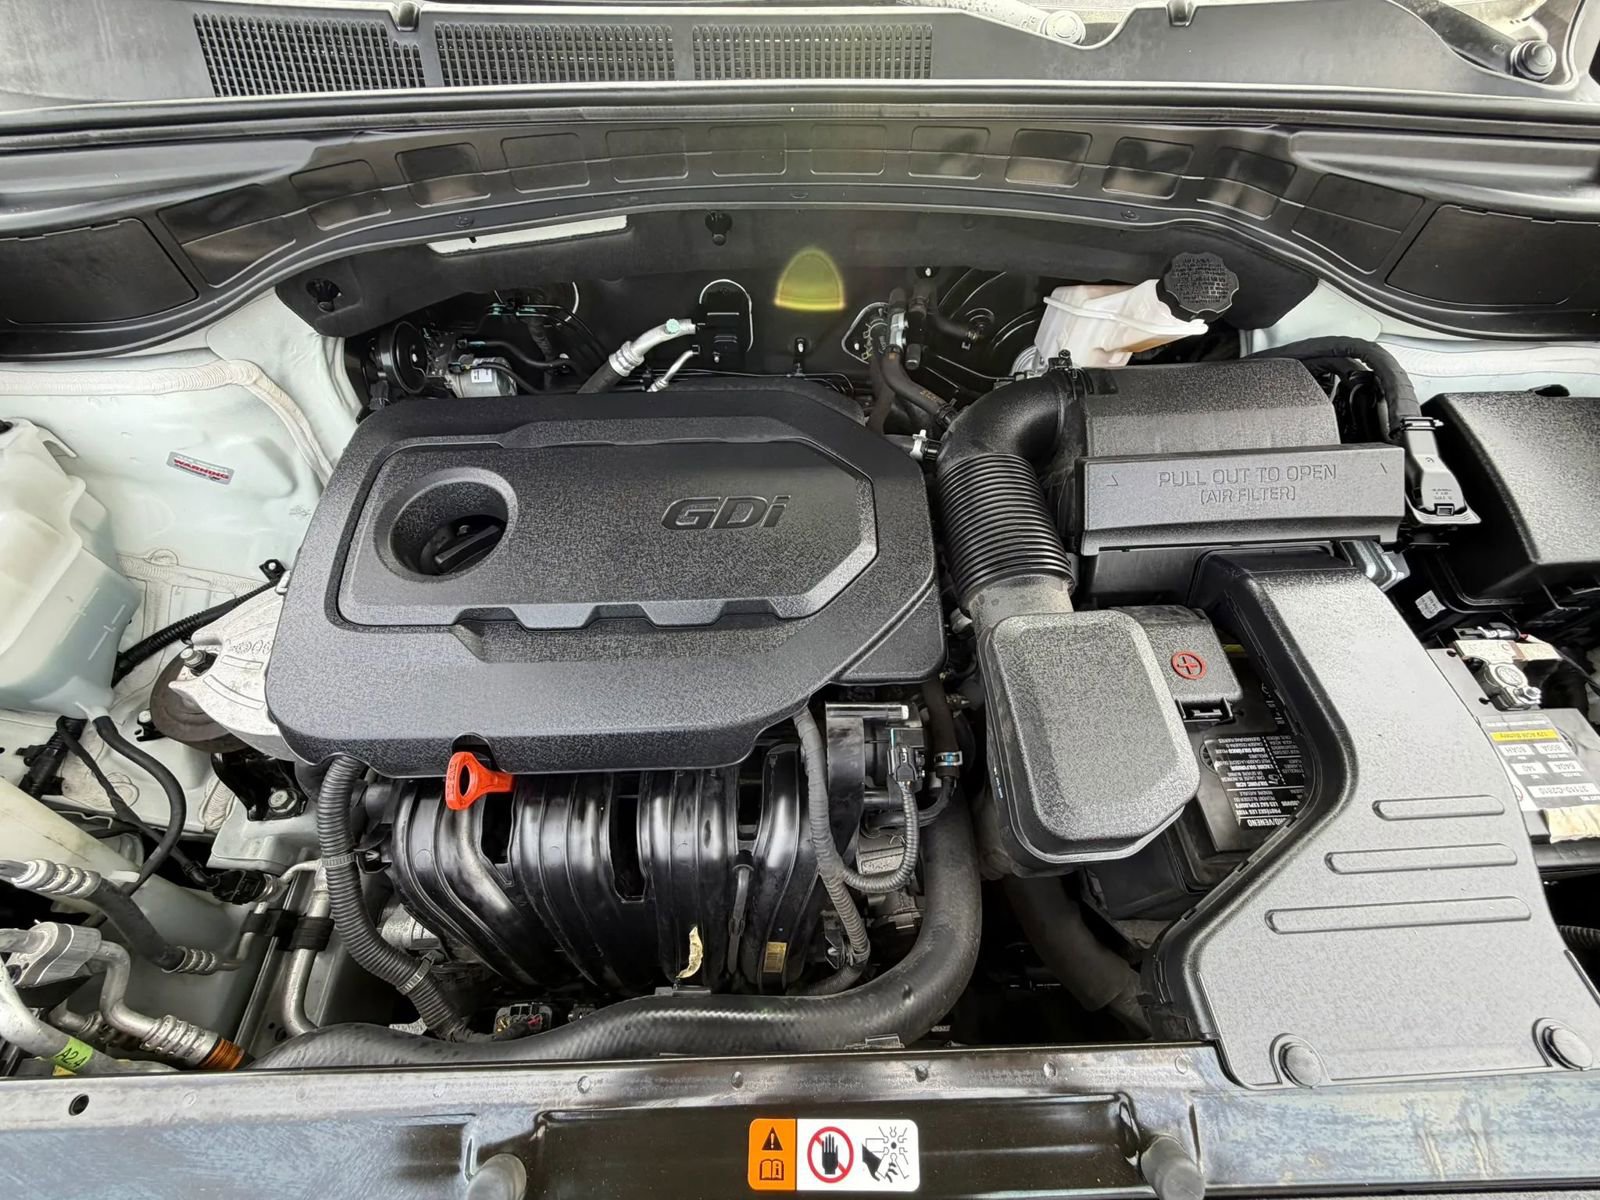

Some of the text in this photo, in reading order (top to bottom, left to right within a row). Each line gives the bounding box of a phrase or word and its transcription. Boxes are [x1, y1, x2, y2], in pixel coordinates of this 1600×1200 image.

[174, 459, 230, 479] WARNING
[1159, 464, 1337, 487] PULL OUT TO OPEN
[1200, 486, 1296, 504] (AIR FILTER)
[661, 495, 791, 530] GDi
